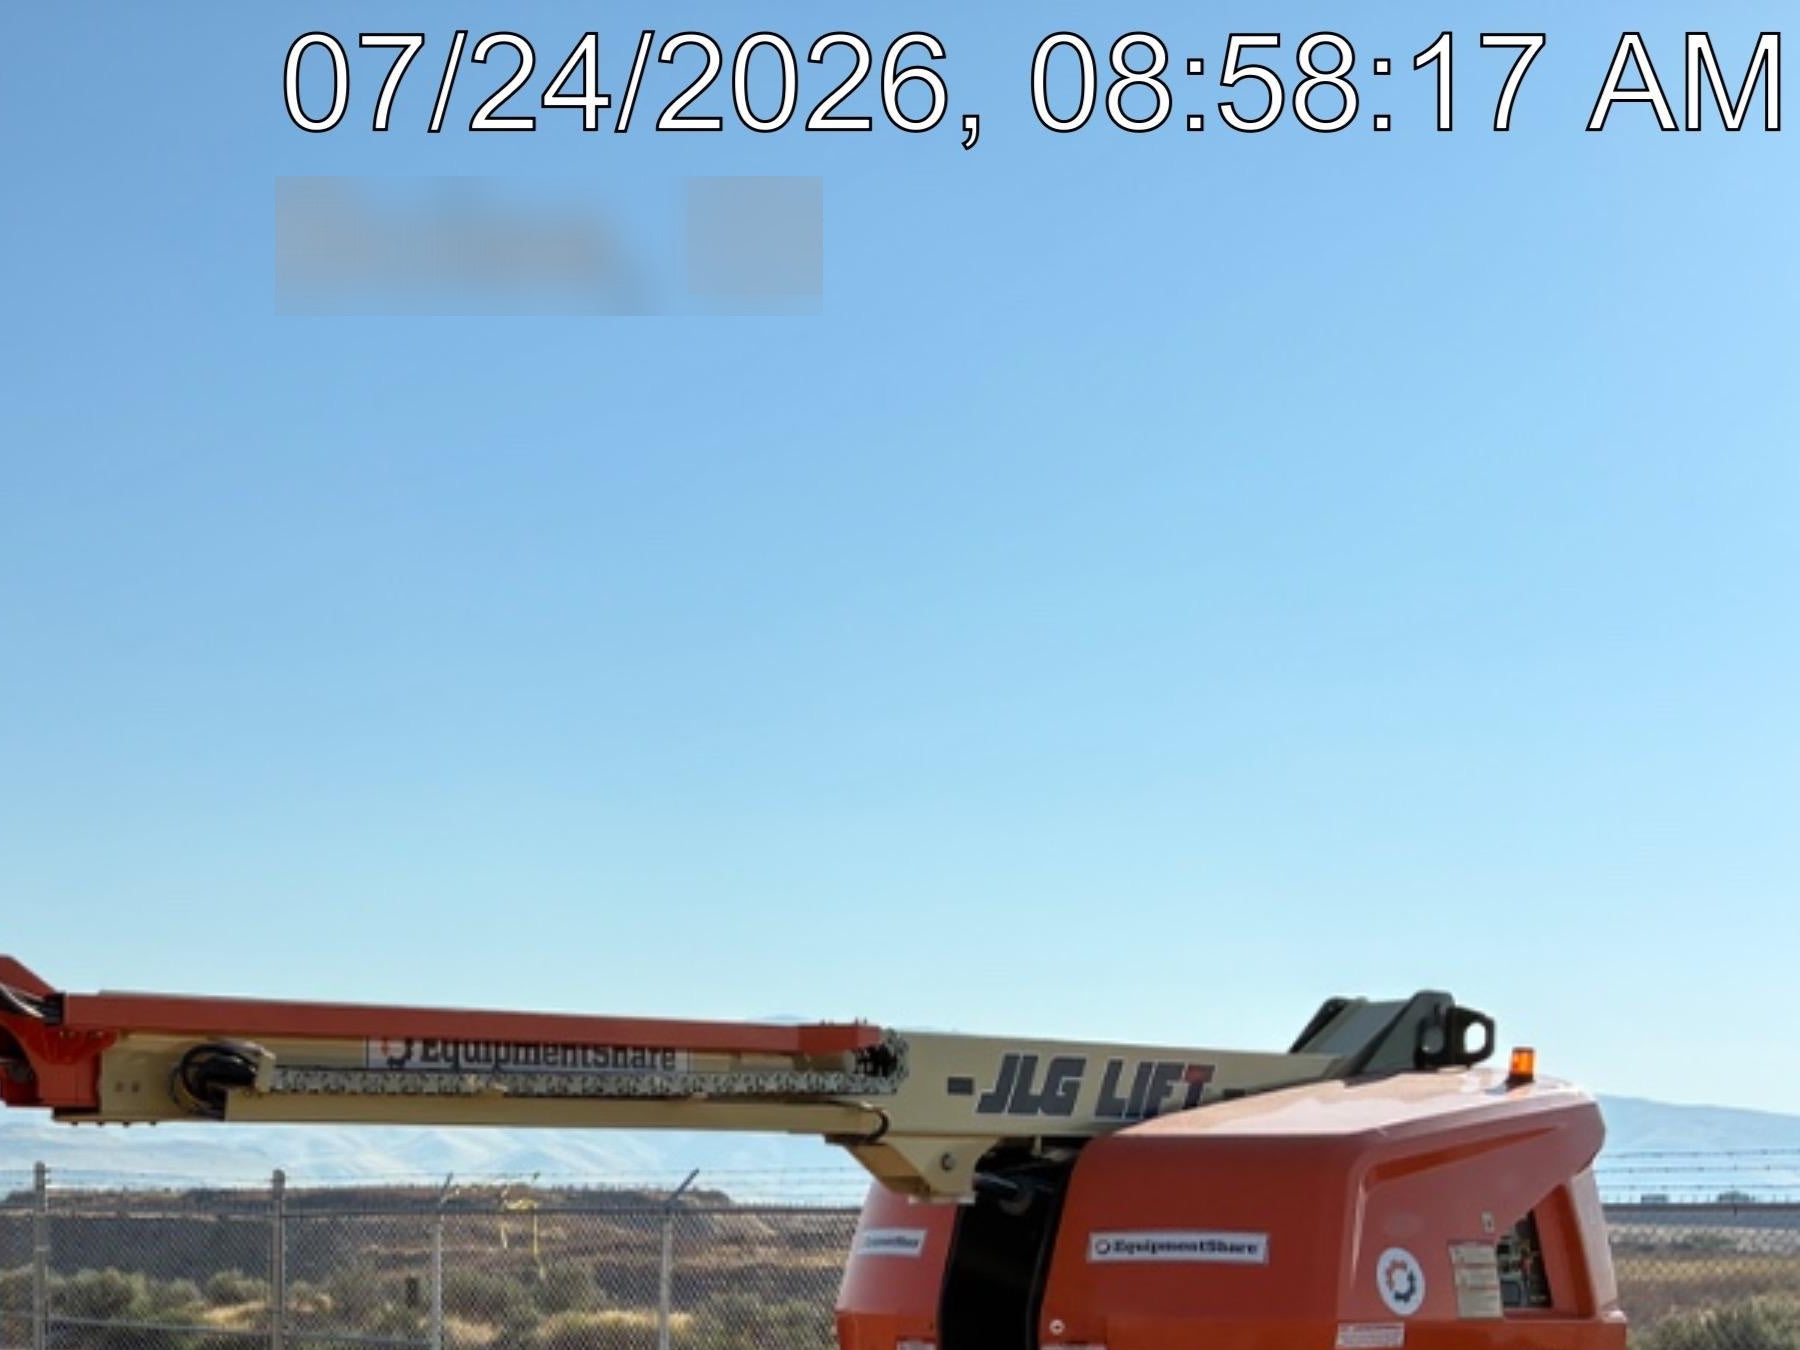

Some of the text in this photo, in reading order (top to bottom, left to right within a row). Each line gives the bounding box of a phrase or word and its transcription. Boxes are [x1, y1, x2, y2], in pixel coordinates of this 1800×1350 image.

[976, 1054, 1216, 1118] JLG LIFT
[1114, 1239, 1258, 1256] EquipmentShare
